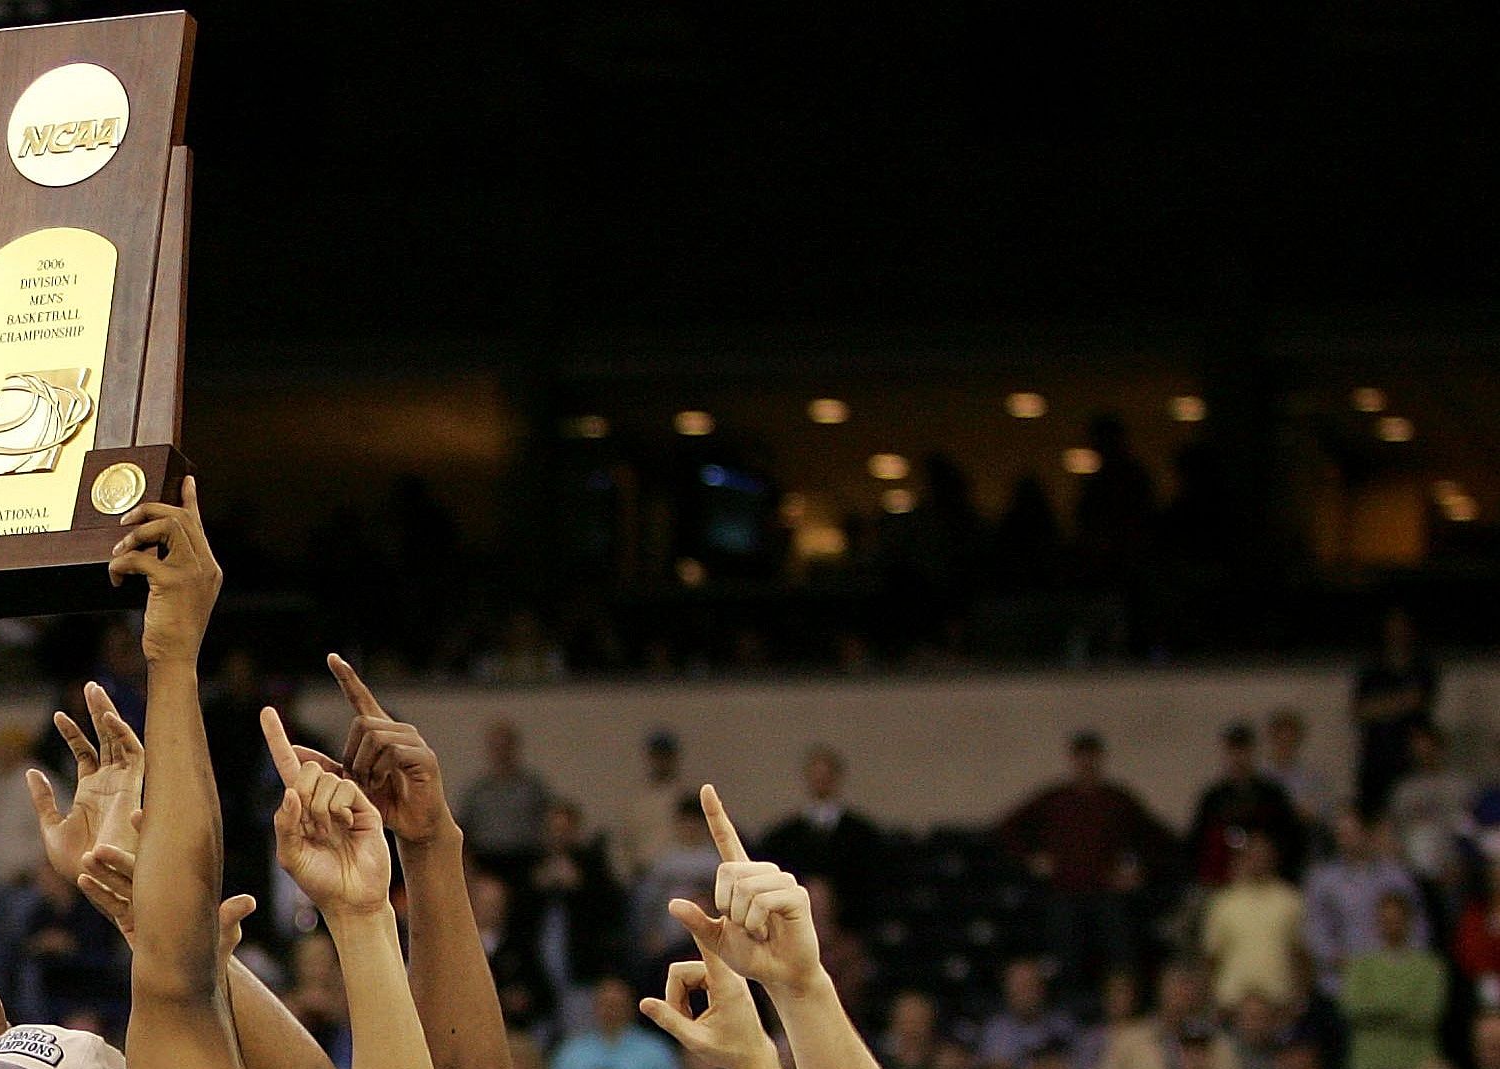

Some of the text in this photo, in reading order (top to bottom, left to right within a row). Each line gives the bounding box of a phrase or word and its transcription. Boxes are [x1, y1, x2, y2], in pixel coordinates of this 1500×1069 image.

[18, 117, 120, 158] NCAA
[37, 258, 65, 271] 2006
[20, 275, 70, 290] DIVISION
[29, 292, 64, 306] MEN'S
[6, 309, 81, 326] BASKETBALL
[0, 326, 85, 344] CHAMPIONSHIP
